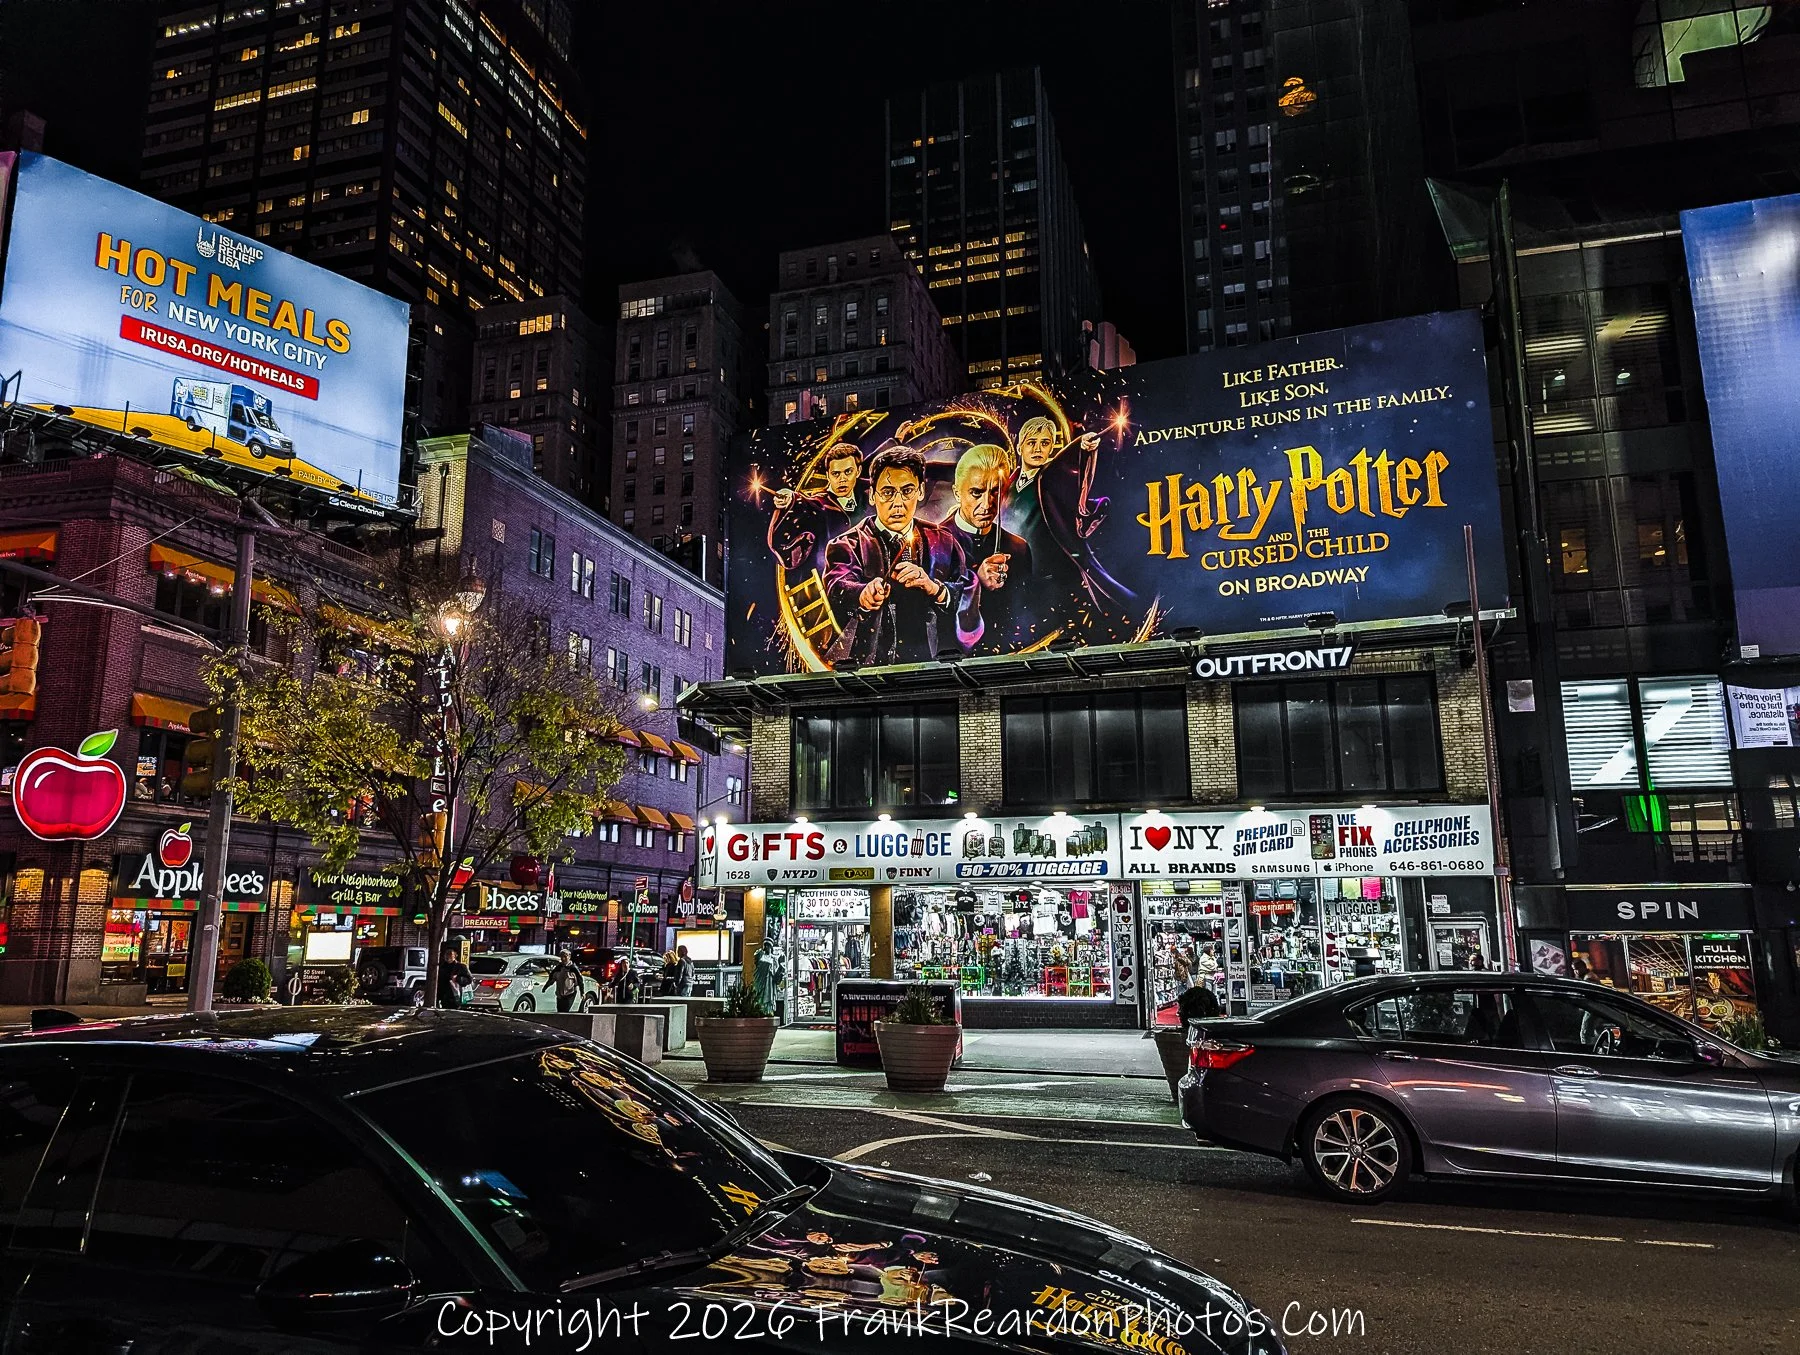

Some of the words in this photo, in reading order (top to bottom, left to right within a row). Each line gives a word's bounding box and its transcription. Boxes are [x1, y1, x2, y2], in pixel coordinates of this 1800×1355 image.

[218, 244, 256, 265] RELIEF
[219, 234, 264, 261] ISLAMIC
[217, 254, 241, 270] USA
[95, 231, 197, 297] HOT
[208, 273, 351, 354] MEALS
[120, 285, 159, 314] FOR
[168, 301, 220, 333] NEW
[223, 319, 280, 357] YORK
[283, 341, 328, 371] CITY
[140, 325, 305, 390] IRUSA.ORG/HOTMEALS
[1223, 369, 1262, 389] LIKE
[1267, 357, 1344, 381] FATHER.
[1240, 389, 1279, 408] LIKE
[1285, 382, 1329, 401] SON.
[1134, 417, 1245, 447] ADVENTURE
[1251, 408, 1301, 428] RUNS
[1306, 405, 1327, 420] IN
[1333, 398, 1372, 415] THE
[1377, 385, 1453, 409] FAMILY.
[298, 470, 316, 482] PAID
[317, 475, 328, 484] BY
[339, 500, 358, 510] Clear
[358, 504, 385, 518] Channel
[1136, 467, 1283, 560] Harry
[1283, 445, 1450, 552] Potter
[1268, 532, 1292, 543] AND
[1307, 527, 1330, 538] THE
[1201, 543, 1298, 571] CURSED
[1305, 532, 1390, 559] CHILD
[1218, 579, 1250, 597] ON
[1255, 566, 1370, 593] BROADWAY
[1337, 813, 1357, 826] WE
[1394, 815, 1471, 837] CELLPHONE
[1129, 826, 1143, 850] I
[1236, 823, 1288, 842] PREPAID
[1338, 825, 1375, 847] FIX
[834, 839, 847, 853] &
[1233, 842, 1257, 857] SIM
[1259, 836, 1294, 853] CARD
[1383, 830, 1480, 854] ACCESSORIES
[1339, 846, 1378, 858] PHONES
[700, 856, 715, 876] NY
[726, 870, 750, 880] 1628
[782, 869, 818, 879] NYPD
[900, 867, 934, 877] FDNY
[960, 863, 1023, 877] 50-70%
[1025, 861, 1103, 876] LUGGAGE
[1128, 863, 1161, 874] ALL
[1168, 863, 1237, 874] BRANDS
[1251, 864, 1310, 873] SAMSUNG
[1335, 861, 1374, 872] iPhone
[1389, 860, 1484, 871] 646-861-0680
[128, 853, 264, 898] Applee's
[340, 872, 399, 889] Neighborhood
[331, 888, 355, 903] Grill
[354, 891, 363, 905] &
[364, 892, 382, 903] Bar
[800, 890, 838, 898] CLOTHING
[806, 898, 816, 907] 30
[818, 898, 830, 907] TO
[642, 903, 658, 914] Room
[675, 894, 715, 918] Applbee's
[1015, 901, 1029, 909] NY
[1335, 902, 1379, 915] LUGGAGE
[1617, 901, 1699, 920] SPIN
[1114, 923, 1134, 932] NY
[1702, 945, 1737, 953] FULL
